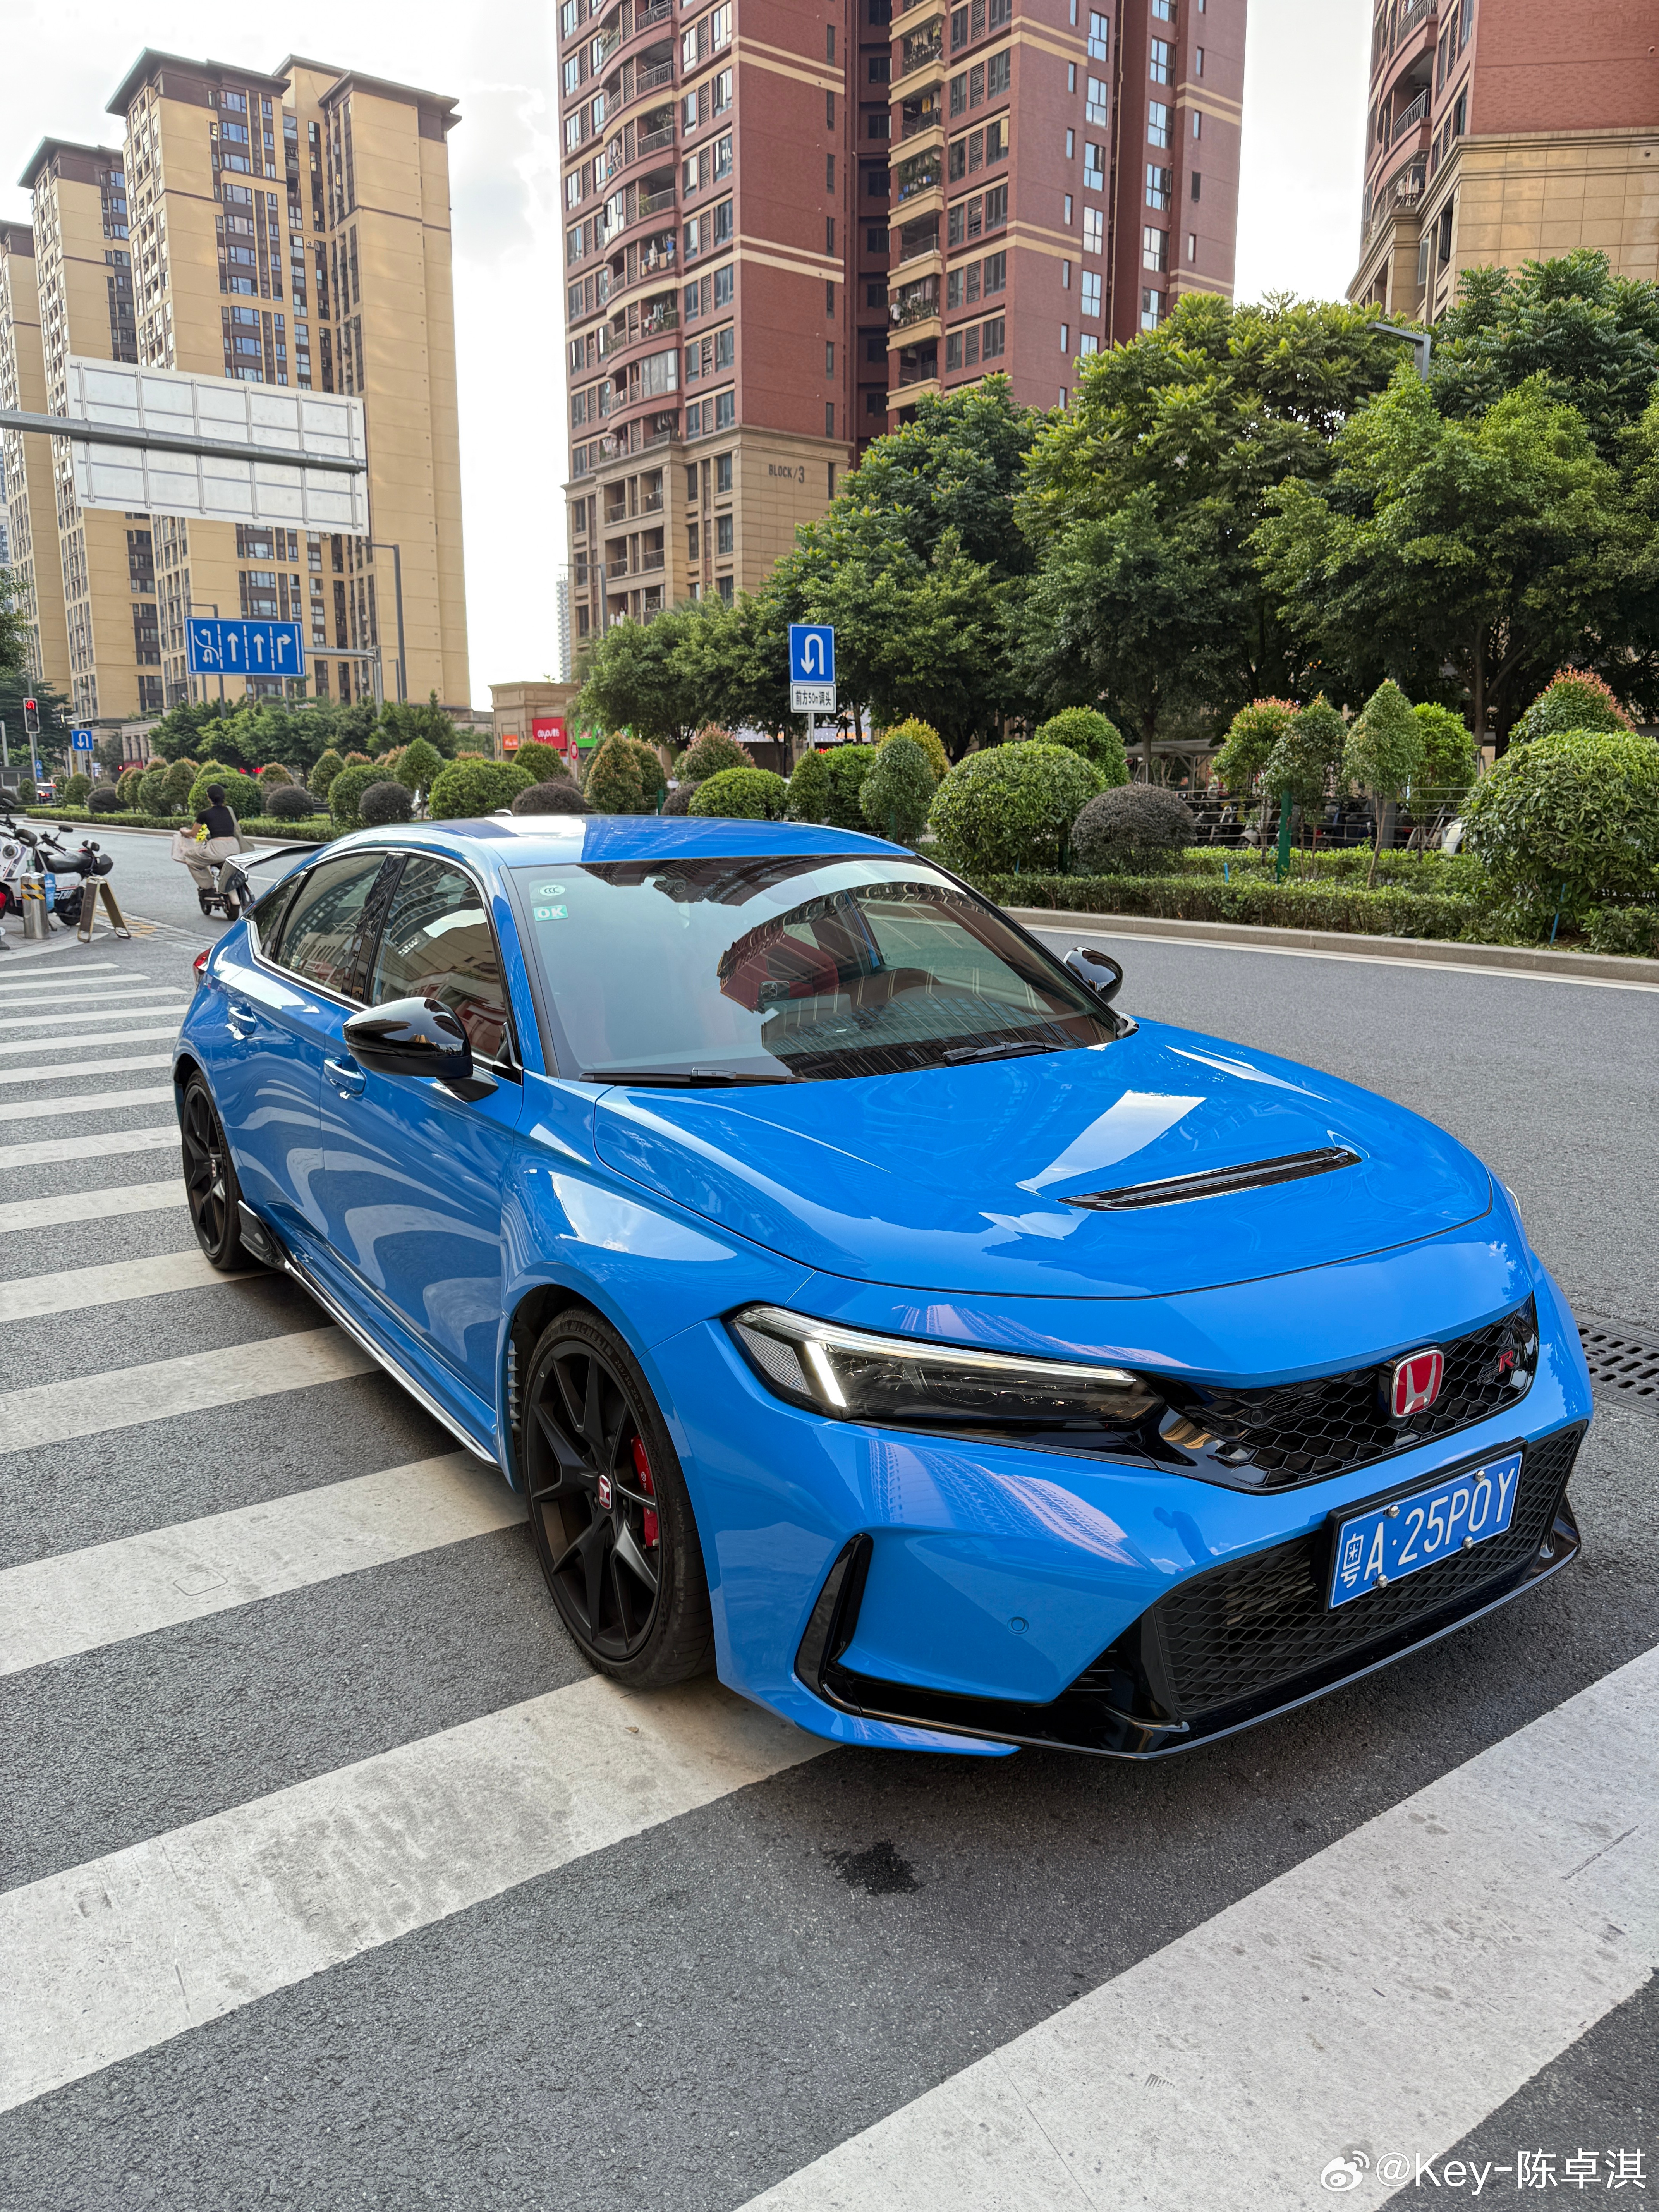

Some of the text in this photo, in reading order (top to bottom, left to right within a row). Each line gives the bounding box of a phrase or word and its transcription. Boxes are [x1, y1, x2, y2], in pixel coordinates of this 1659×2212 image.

[538, 907, 565, 918] OK
[569, 1321, 615, 1356] MICHELIN
[1499, 1350, 1514, 1372] R
[615, 1360, 644, 1413] 265/30 ZR 19
